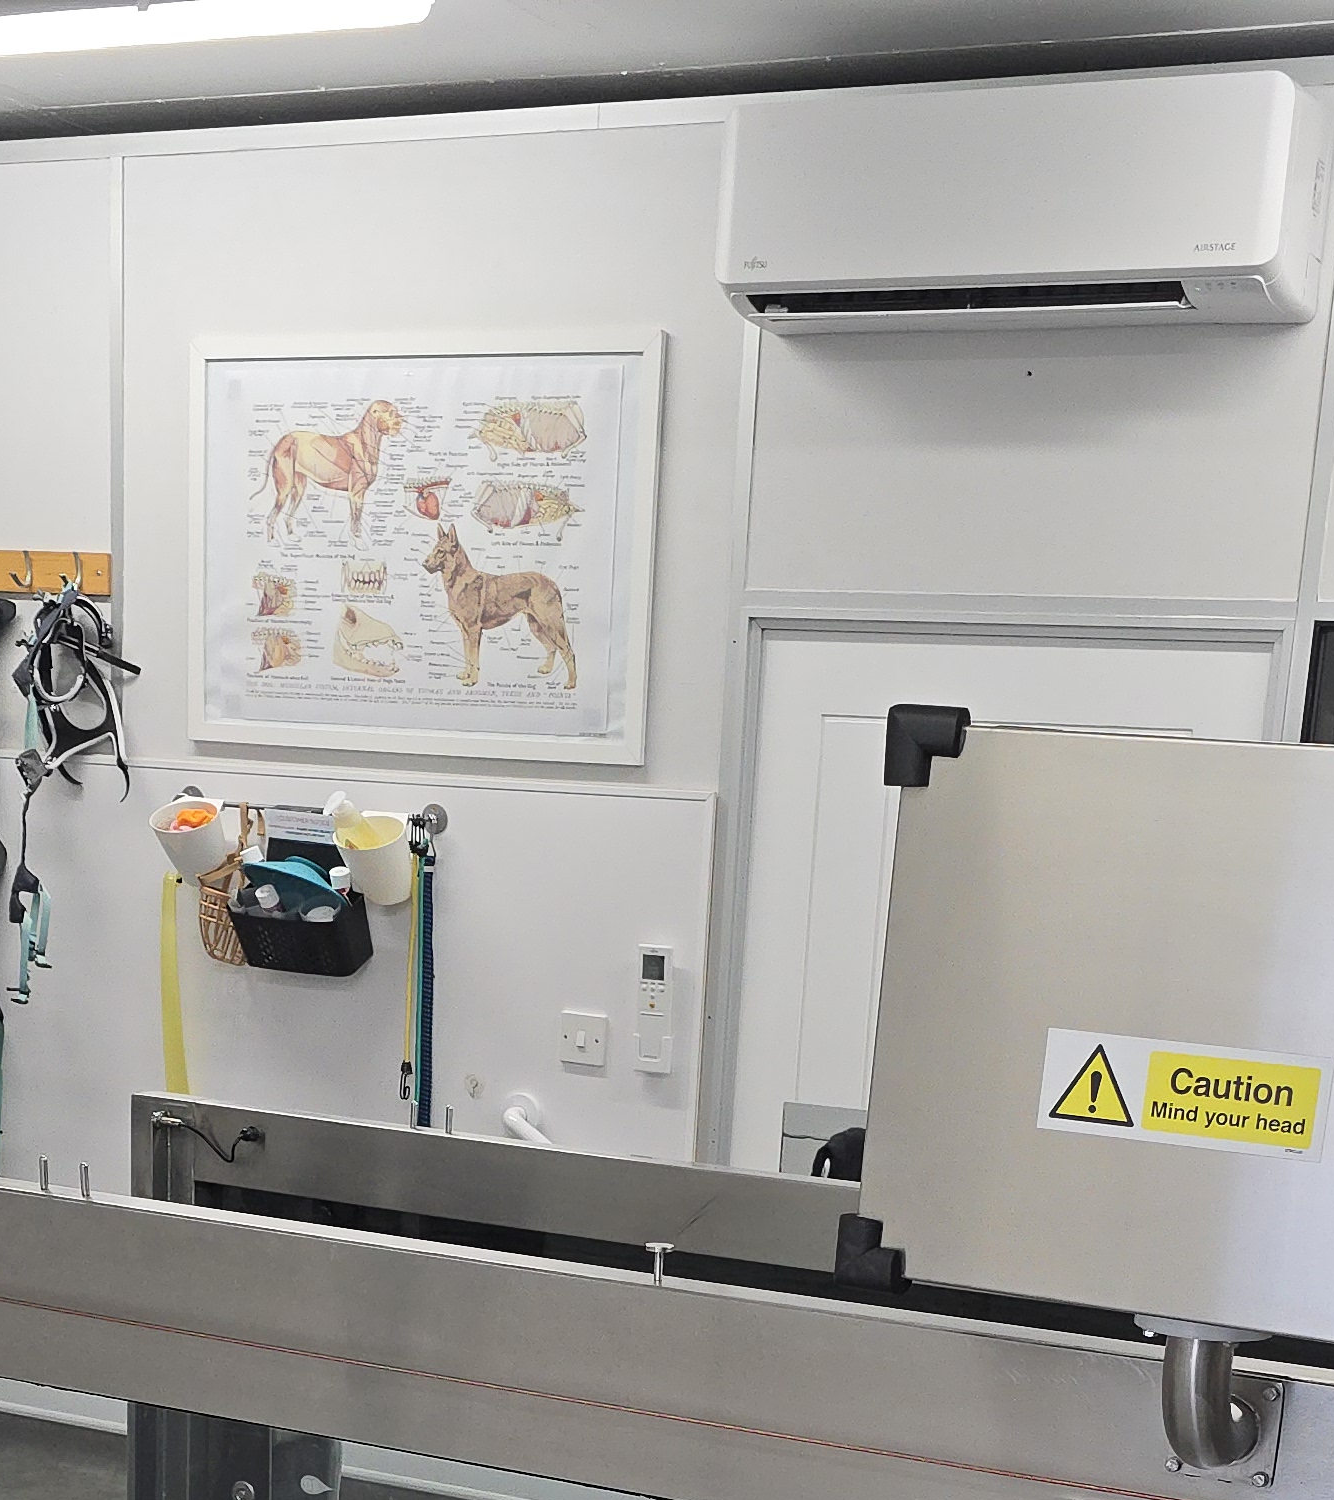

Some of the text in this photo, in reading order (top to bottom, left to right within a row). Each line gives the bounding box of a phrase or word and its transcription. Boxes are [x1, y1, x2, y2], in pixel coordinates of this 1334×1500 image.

[1193, 242, 1236, 253] AIRSTAGE
[1170, 1067, 1294, 1107] Caution
[1151, 1101, 1306, 1135] Mind your head
